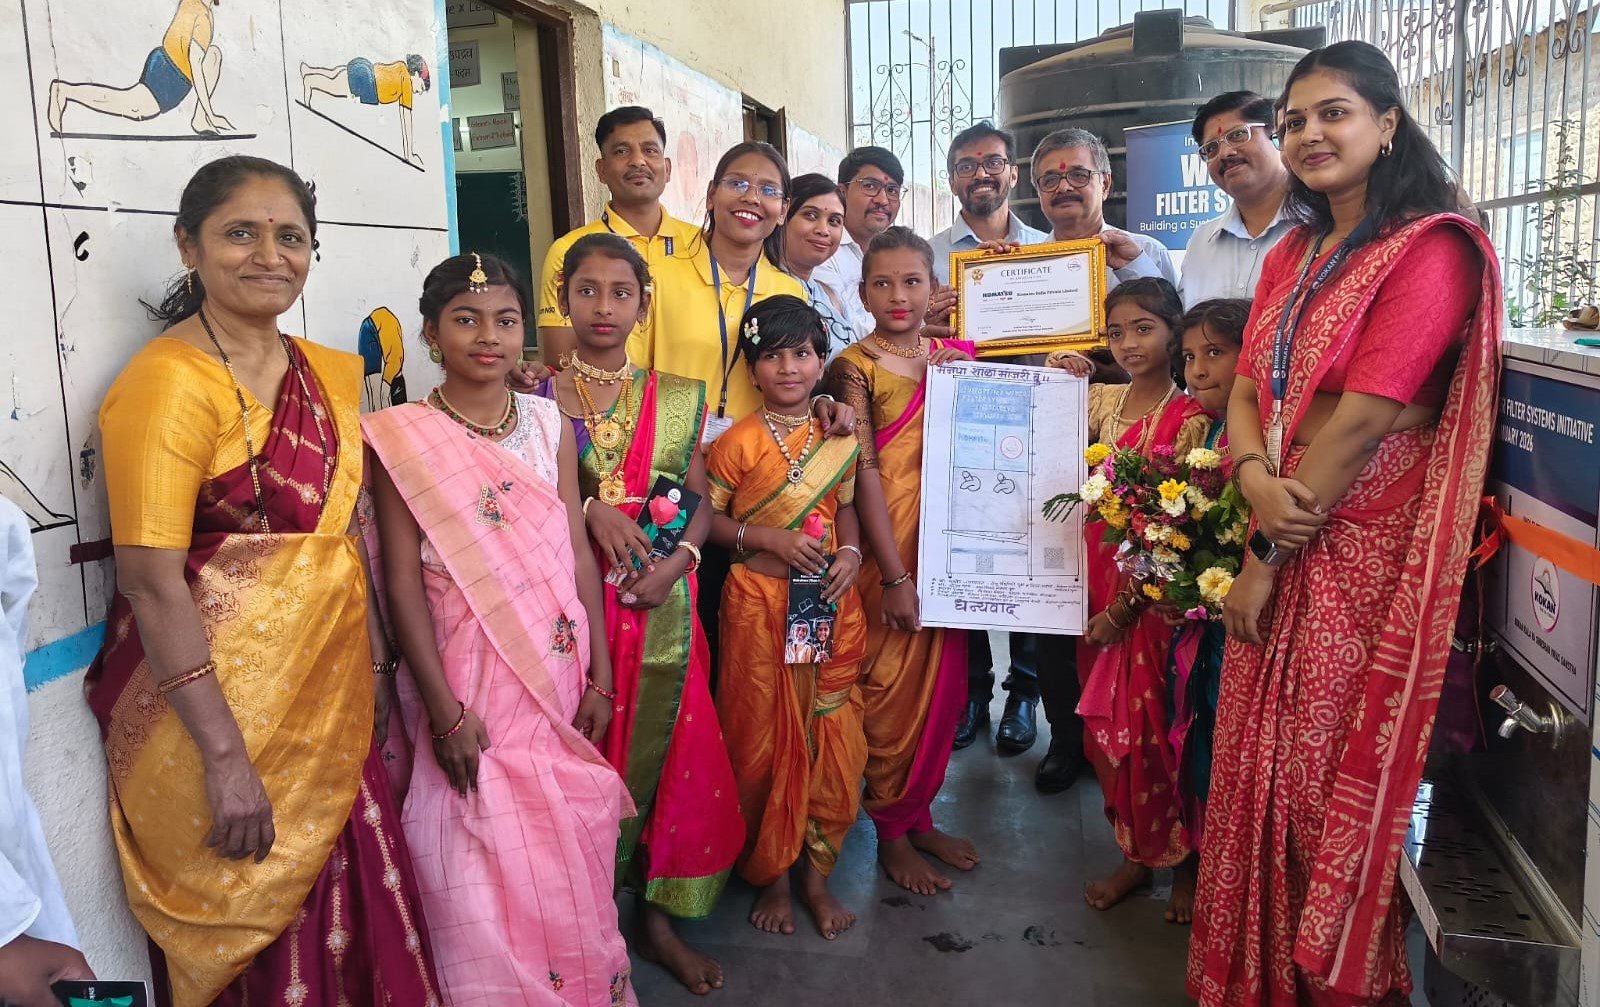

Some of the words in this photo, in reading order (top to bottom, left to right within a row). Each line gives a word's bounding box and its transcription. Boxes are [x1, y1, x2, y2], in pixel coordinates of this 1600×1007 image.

[1184, 135, 1198, 147] In
[1180, 153, 1215, 187] W
[1156, 190, 1210, 216] FILTER
[1213, 189, 1228, 213] S
[1140, 219, 1178, 233] Building
[1180, 222, 1188, 230] a
[1000, 265, 1052, 277] CERTIFICATE
[1506, 399, 1526, 421] FILTER
[1526, 405, 1556, 432] SYSTEMS
[1556, 413, 1594, 444] INITIATIVE
[1519, 430, 1534, 452] 2026
[1534, 591, 1557, 615] KOKAN
